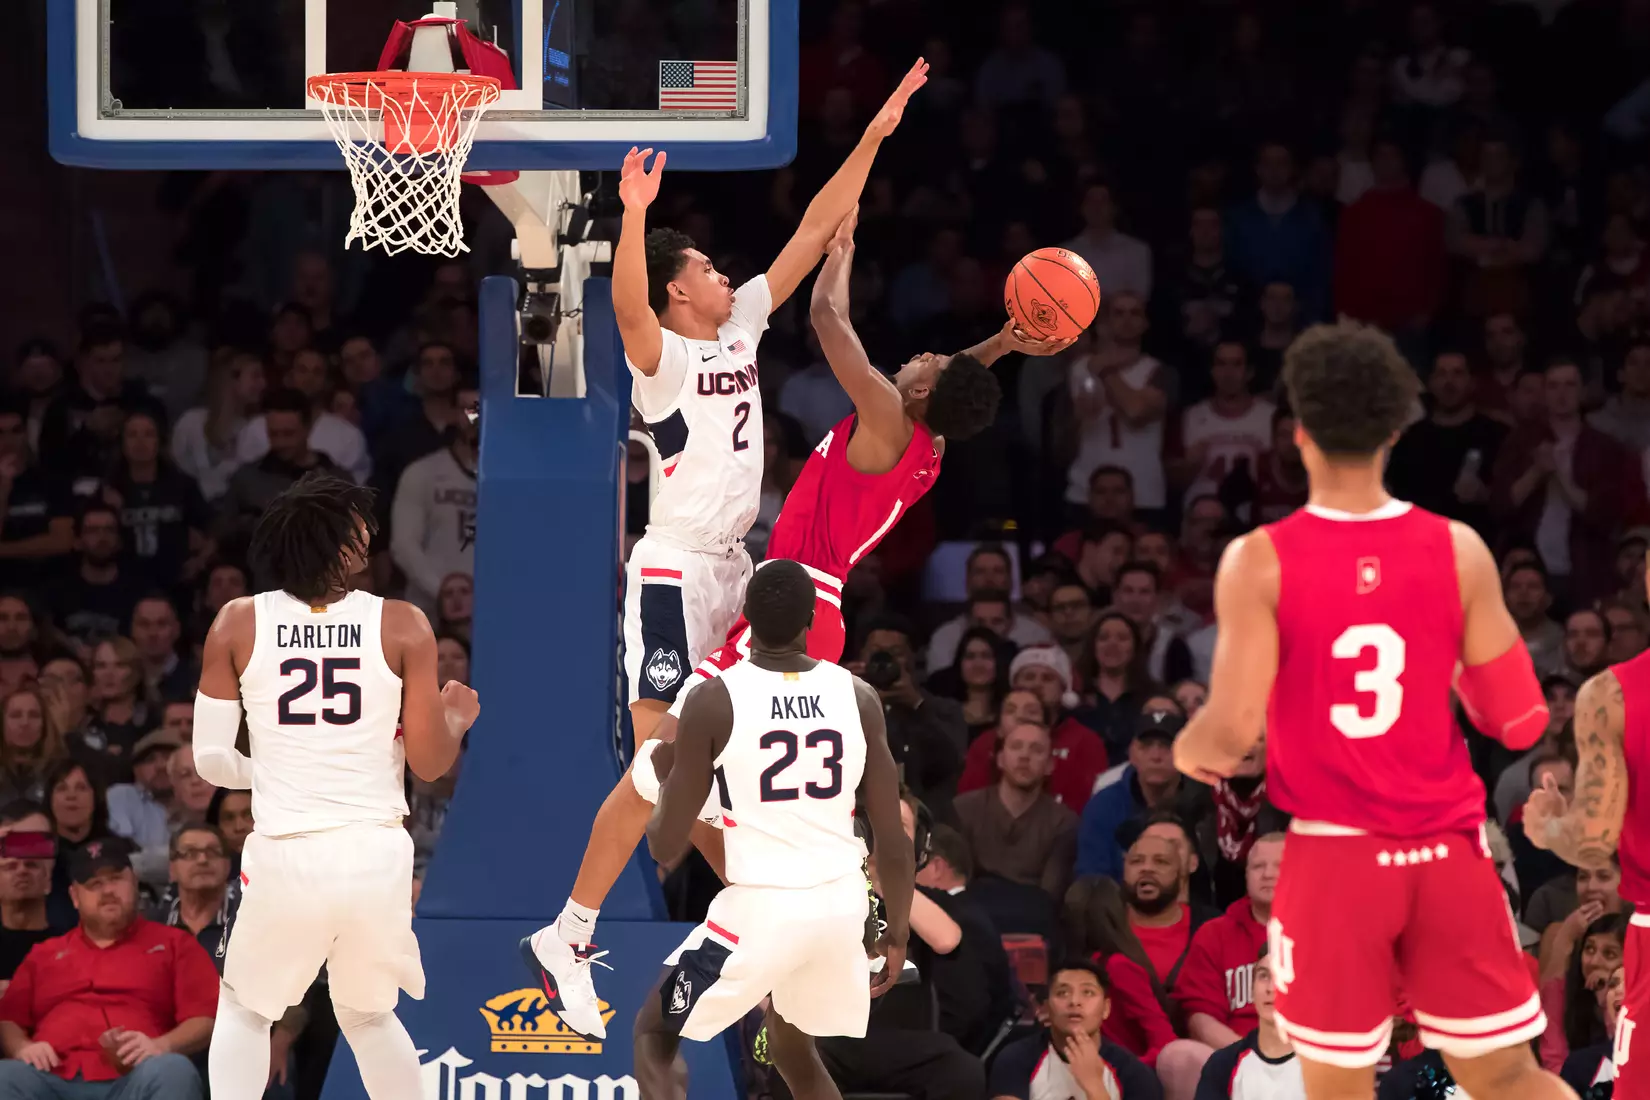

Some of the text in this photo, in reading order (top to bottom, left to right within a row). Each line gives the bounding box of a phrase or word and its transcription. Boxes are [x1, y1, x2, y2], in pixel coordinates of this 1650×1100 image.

[732, 401, 751, 452] 2
[277, 624, 362, 648] CARLTON
[277, 657, 362, 725] 25
[771, 695, 825, 719] AKOK
[1329, 623, 1406, 739] 3
[759, 728, 844, 802] 23
